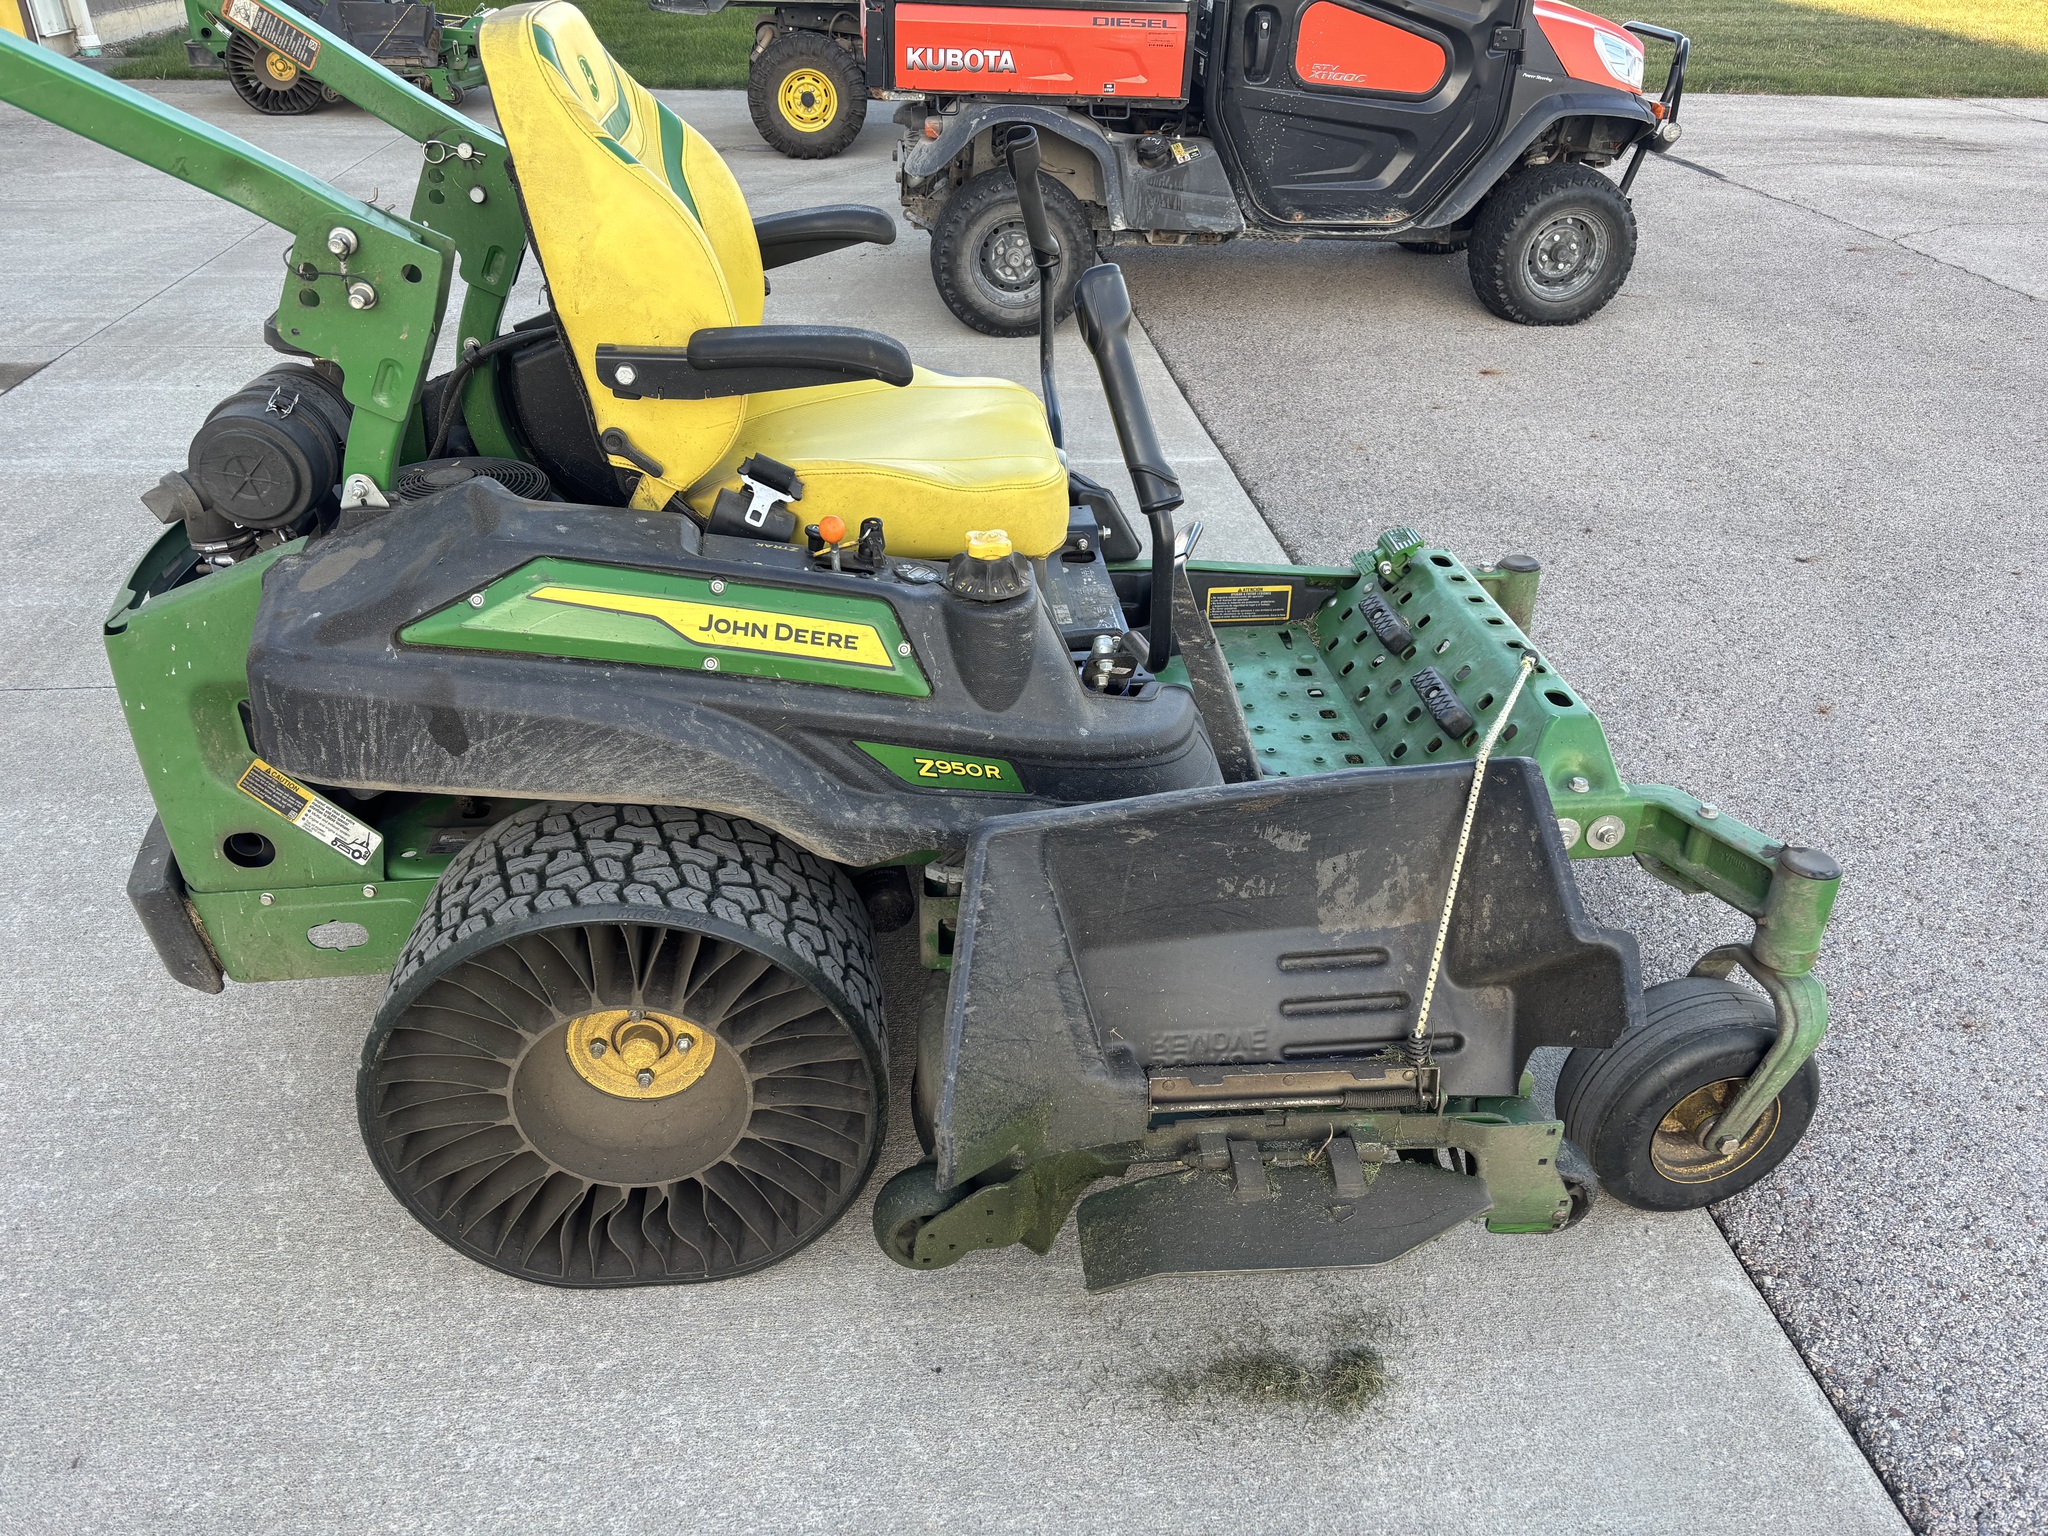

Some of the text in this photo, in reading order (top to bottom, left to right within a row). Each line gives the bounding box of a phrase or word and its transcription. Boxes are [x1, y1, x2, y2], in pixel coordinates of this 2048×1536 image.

[1093, 17, 1177, 29] DIESEL
[906, 47, 1017, 73] KUBOTA
[699, 614, 859, 651] JOHN DEERE
[914, 757, 1003, 780] Z950R
[270, 771, 299, 791] CAUTION
[617, 907, 713, 930] MICHELIN
